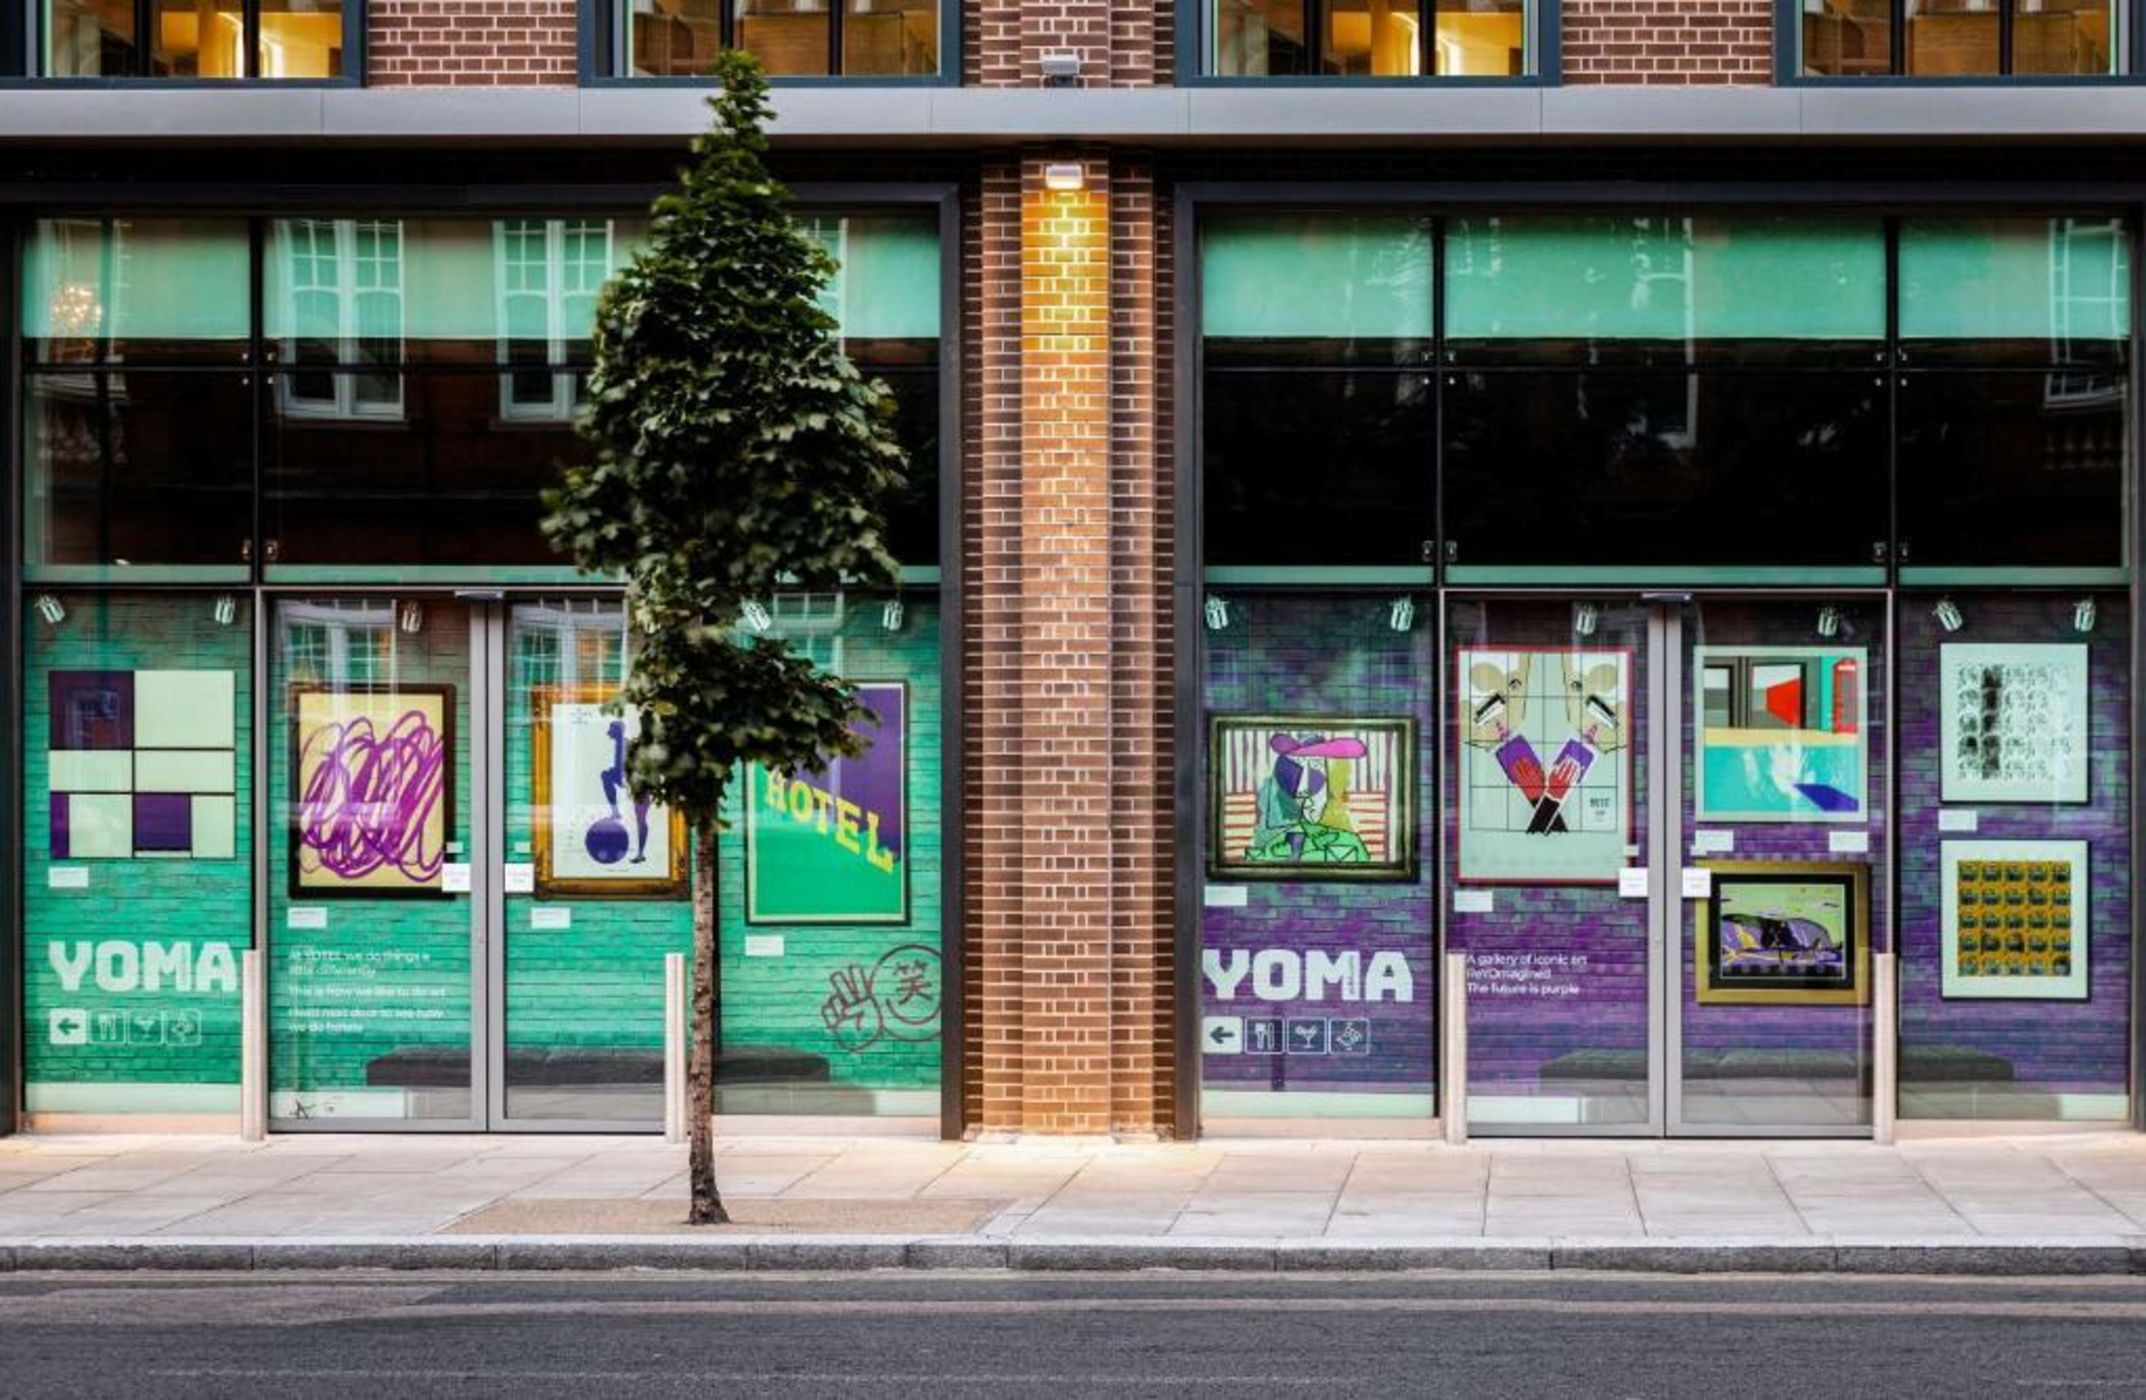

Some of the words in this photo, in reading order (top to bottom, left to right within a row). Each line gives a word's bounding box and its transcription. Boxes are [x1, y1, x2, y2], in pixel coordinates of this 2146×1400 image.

[766, 767, 893, 874] HOTEL
[49, 939, 238, 993] YOMA
[1202, 948, 1414, 1002] YOMA
[1467, 954, 1476, 965] A
[1477, 954, 1518, 967] gallery
[1520, 954, 1532, 965] of
[1534, 953, 1569, 965] iconic
[1467, 982, 1489, 994] The
[1491, 982, 1528, 994] future
[1529, 982, 1540, 994] is
[1541, 983, 1580, 997] purple
